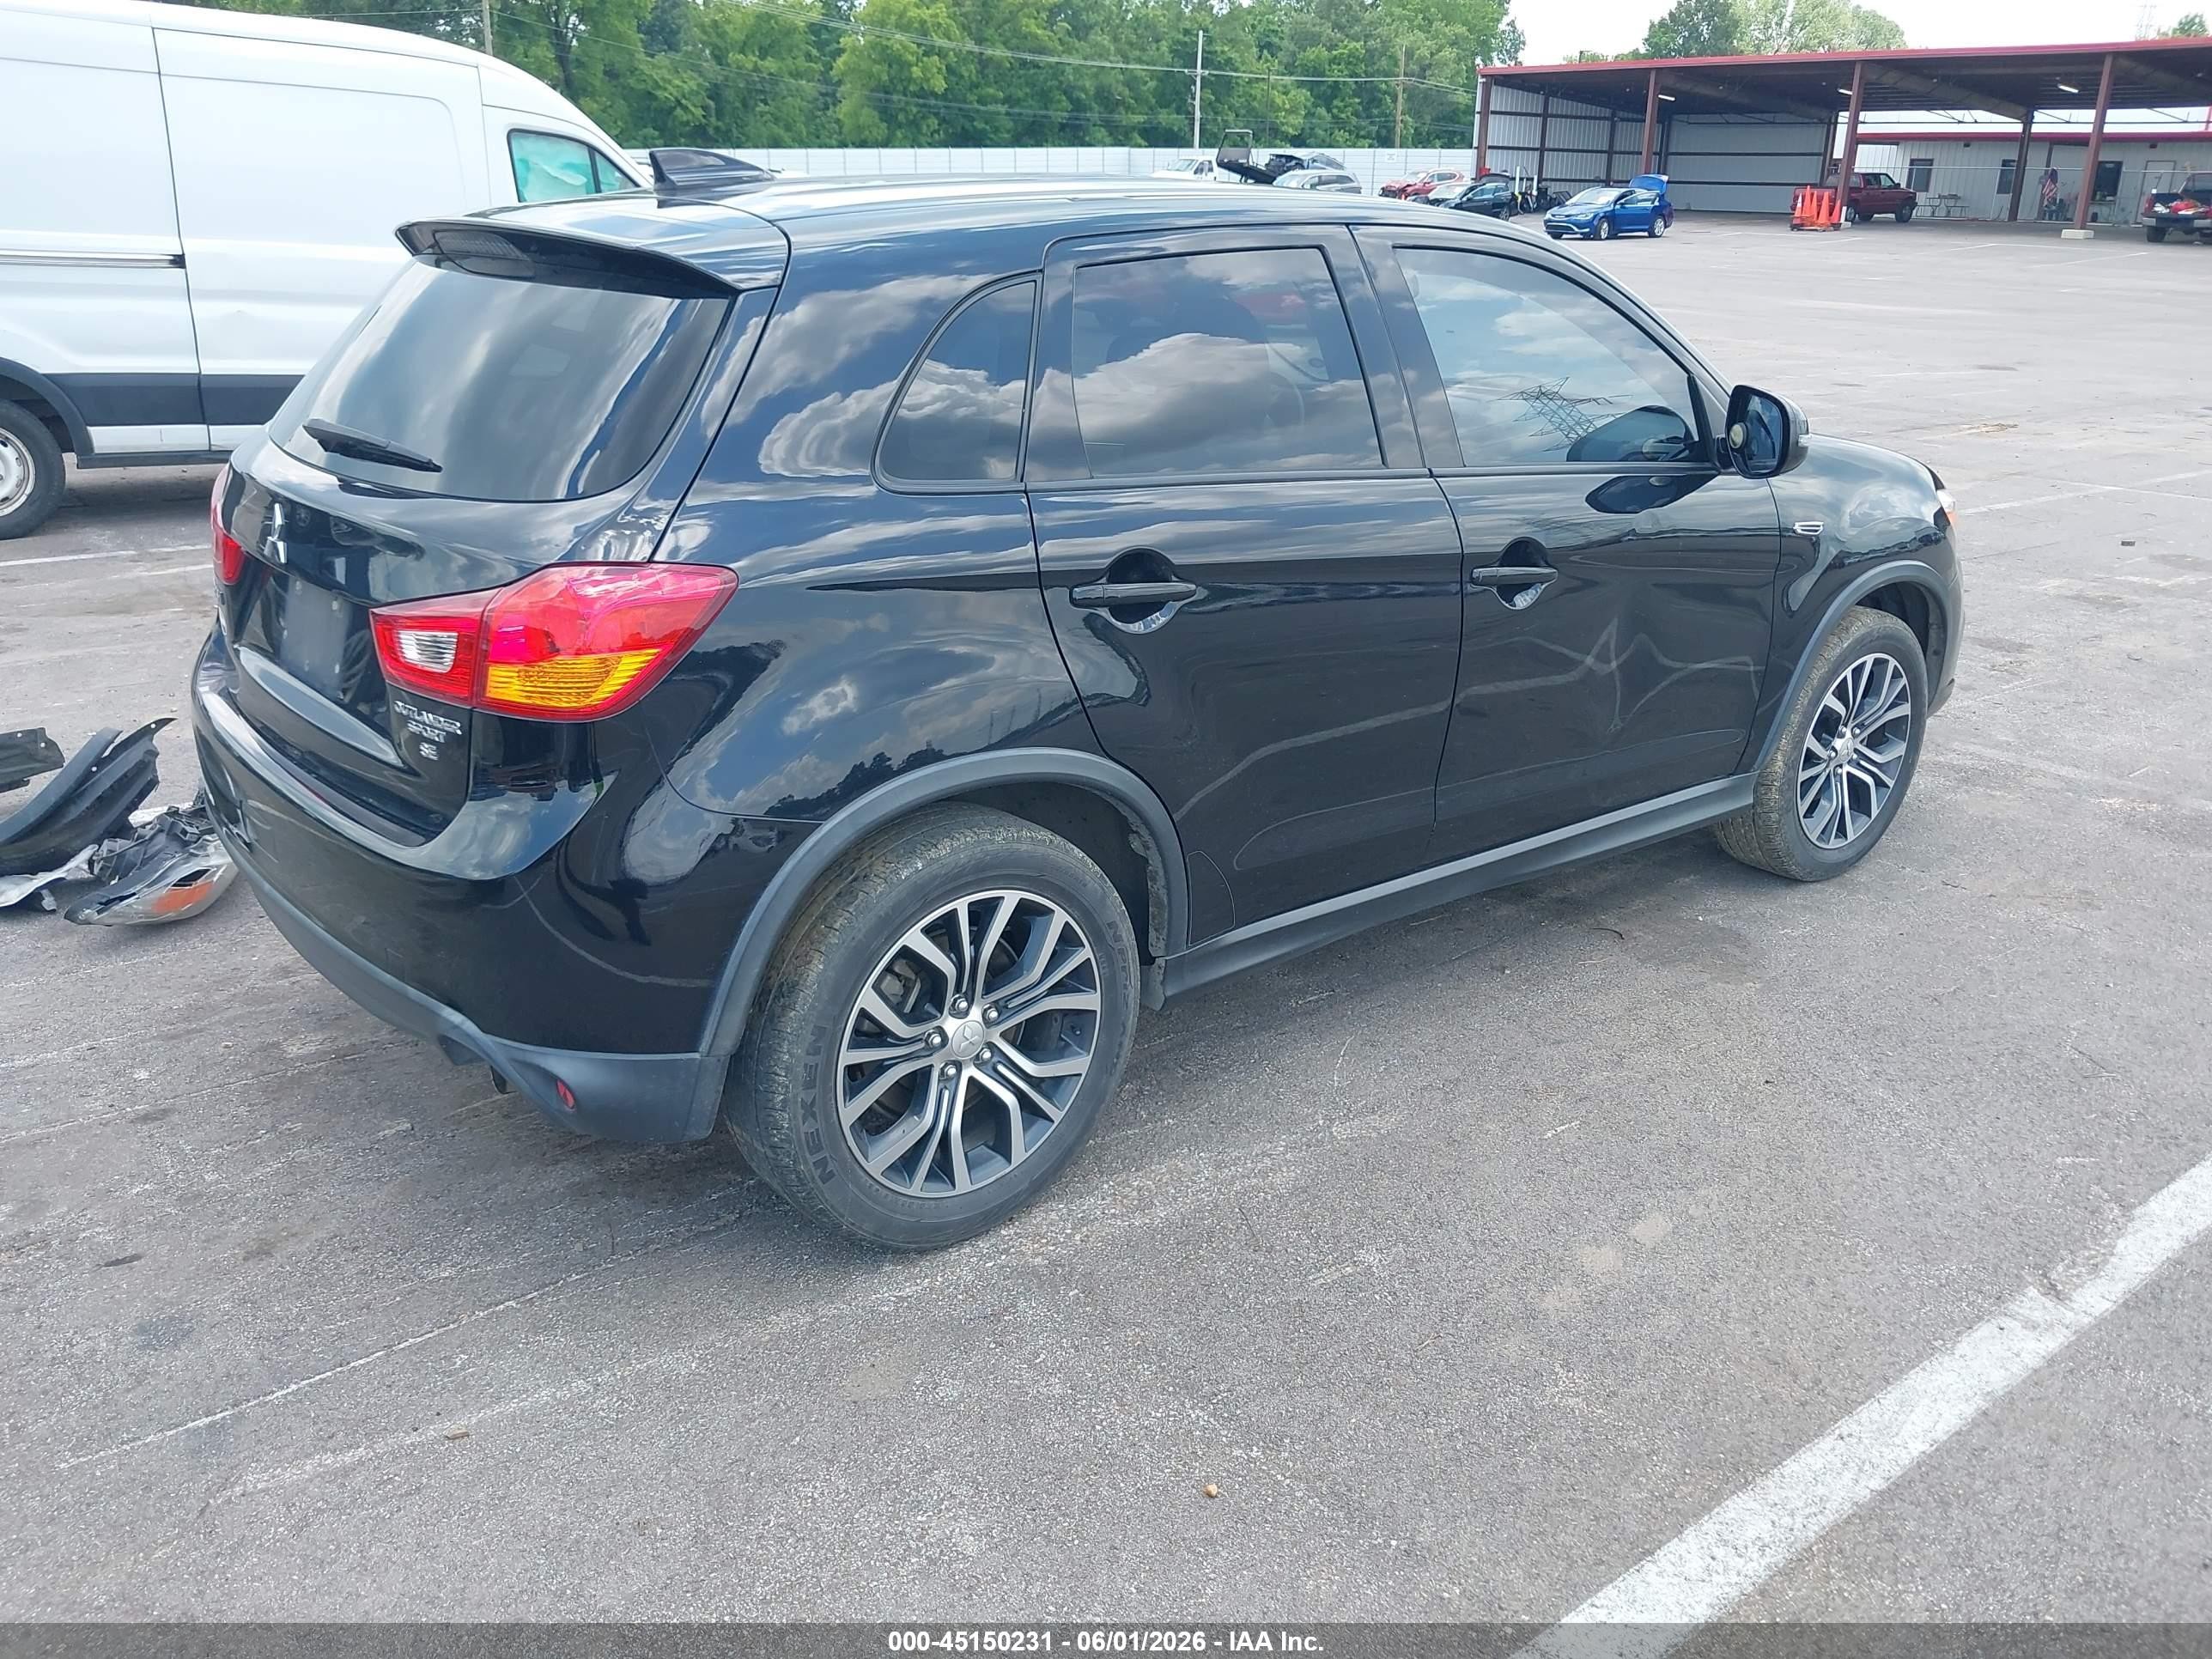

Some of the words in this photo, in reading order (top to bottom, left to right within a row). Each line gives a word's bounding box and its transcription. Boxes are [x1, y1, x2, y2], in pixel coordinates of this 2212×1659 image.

[393, 701, 462, 735] OUTLANDER
[406, 720, 447, 743] SPORT
[799, 1024, 836, 1185] NEXEN
